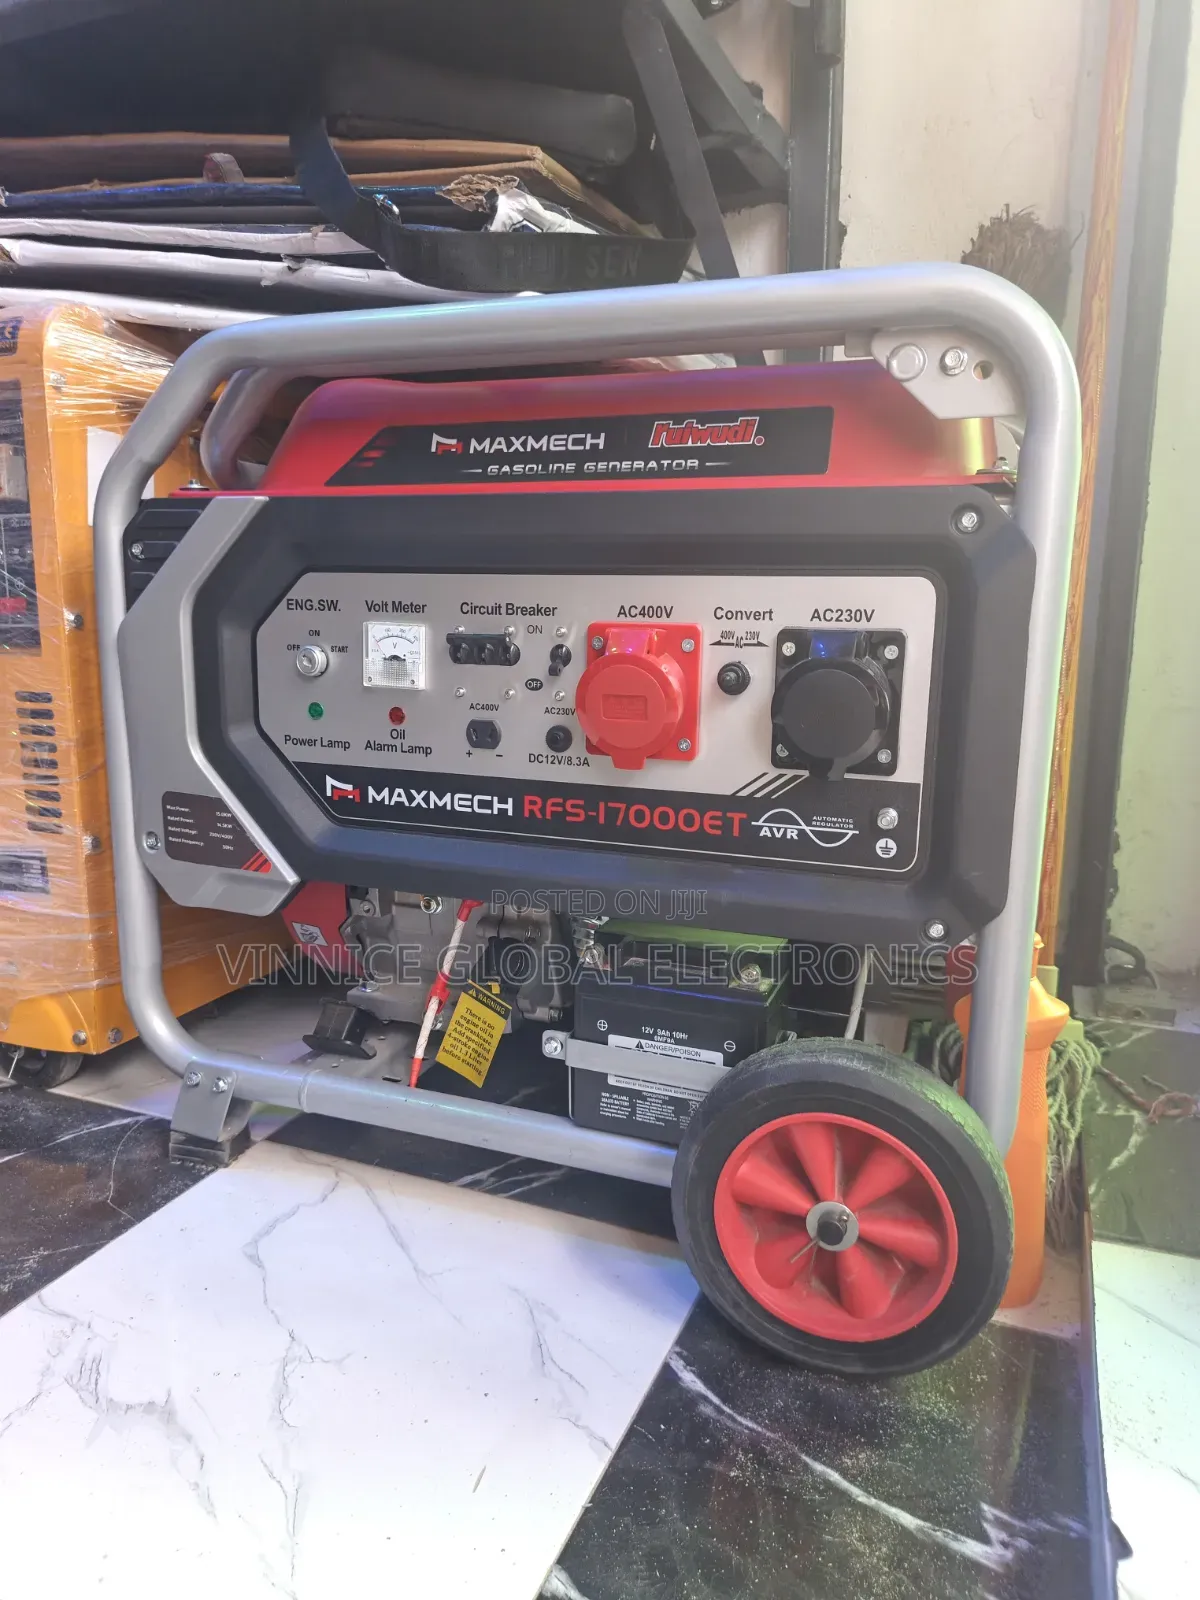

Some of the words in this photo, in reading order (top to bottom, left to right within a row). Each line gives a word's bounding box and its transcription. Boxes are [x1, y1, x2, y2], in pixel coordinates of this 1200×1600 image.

[469, 432, 605, 455] MAXMECH
[487, 462, 576, 475] GASOLINE
[583, 459, 699, 473] GENERATOR
[286, 599, 342, 612] ENG.SW.
[365, 600, 388, 613] Volt
[391, 601, 427, 614] Meter
[460, 602, 502, 616] Circuit
[505, 603, 558, 617] Breaker
[617, 605, 674, 619] AC400V
[713, 607, 774, 621] Convert
[810, 608, 875, 623] AC230V
[527, 624, 543, 634] ON
[720, 630, 736, 640] 400V
[745, 630, 761, 641] 230V
[287, 644, 301, 652] OFF
[735, 636, 744, 648] AC
[330, 645, 349, 654] START
[527, 680, 542, 689] OFF
[469, 702, 500, 712] AC400V
[544, 706, 576, 717] AC230V
[390, 729, 405, 740] Oil
[284, 734, 318, 748] Power
[320, 737, 351, 751] Lamp
[364, 741, 397, 754] Alarm
[400, 743, 432, 757] Lamp
[528, 753, 590, 768] DC12V/8.3A
[368, 785, 513, 816] MAXMECH
[523, 795, 748, 837] RFS-17000ET
[811, 821, 854, 829] REGULATOR
[812, 815, 853, 824] AUTOMATIC
[759, 826, 799, 840] AVR
[478, 993, 506, 1015] WARNING
[454, 1019, 465, 1028] the
[460, 1015, 479, 1029] engine
[479, 1025, 488, 1035] oil
[465, 1007, 482, 1021] There
[487, 1021, 495, 1030] no
[641, 1026, 654, 1034] 12V
[656, 1028, 671, 1037] 9Ah
[672, 1031, 688, 1040] 10Hr
[447, 1032, 472, 1050] 4-stroke
[471, 1047, 490, 1063] engine
[452, 1027, 466, 1038] Add
[465, 1035, 491, 1055] specified
[441, 1046, 461, 1061] before
[450, 1043, 459, 1051] oil
[469, 1052, 483, 1066] Liter
[644, 1042, 701, 1058] DANGER/POISON
